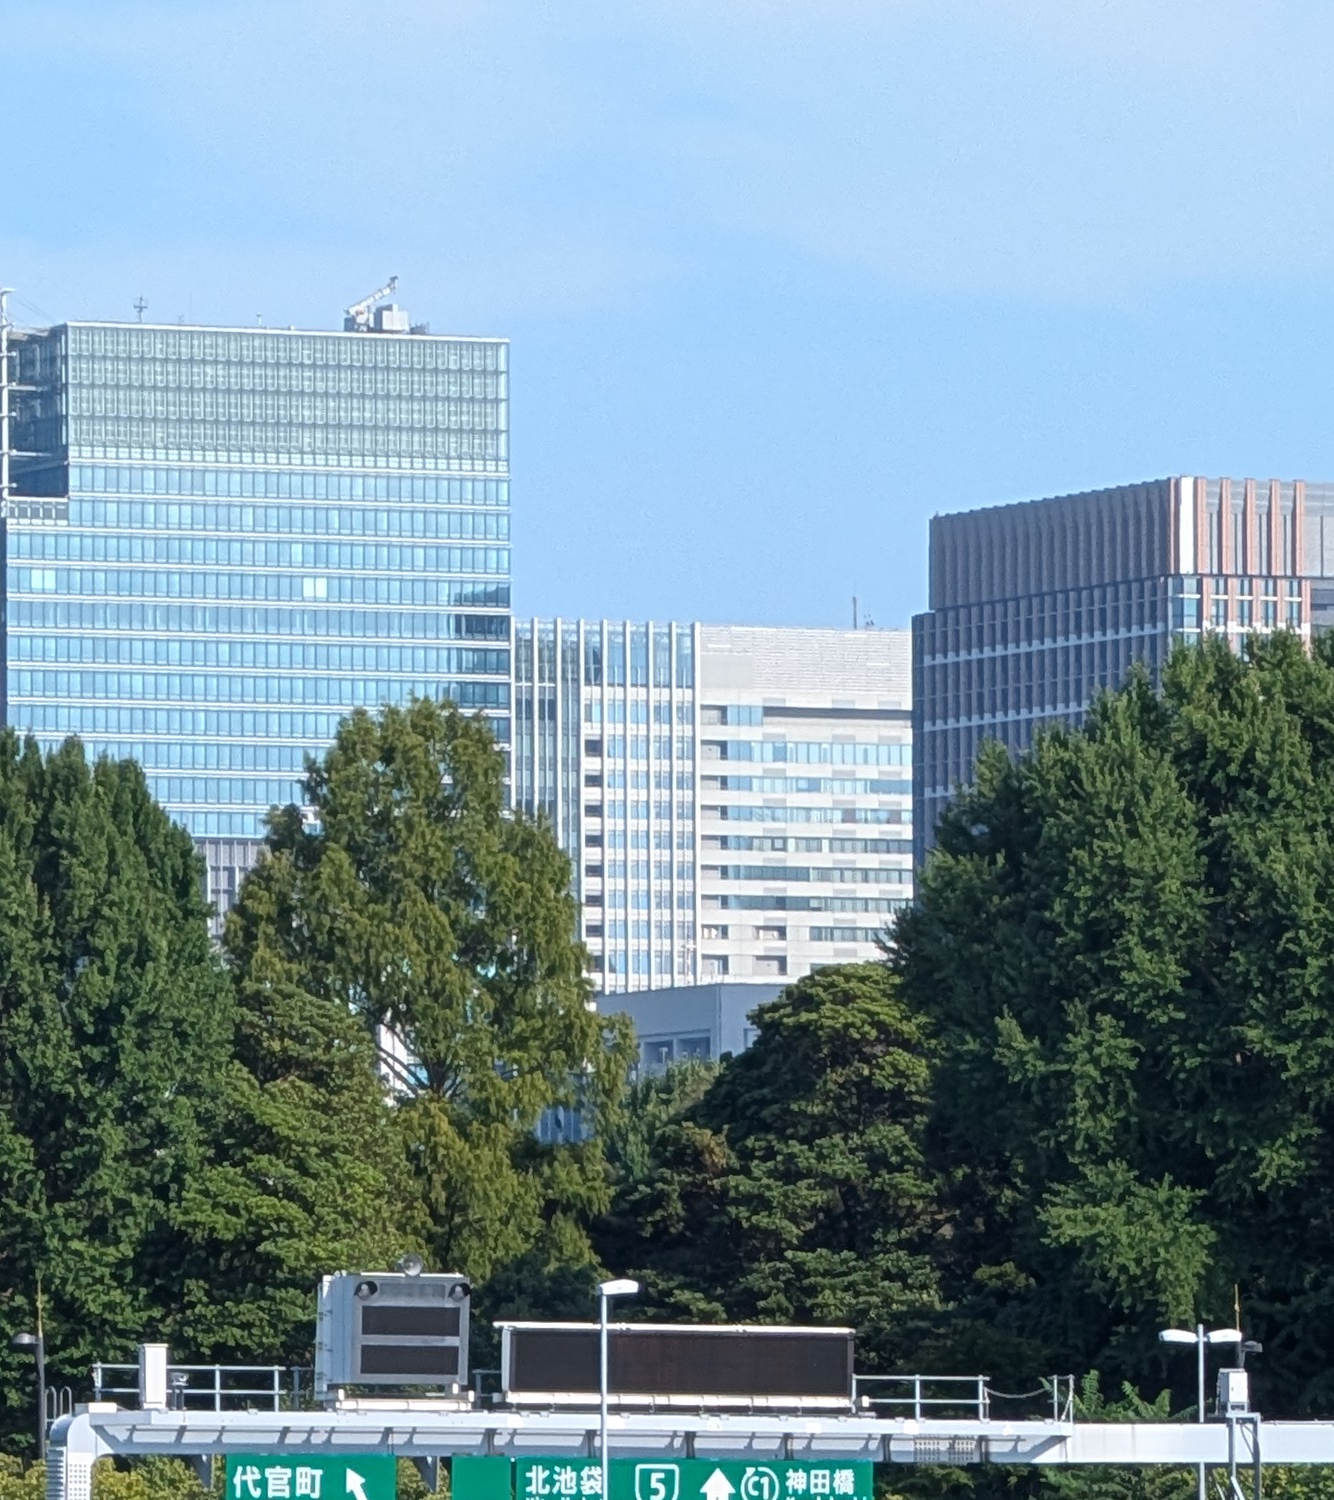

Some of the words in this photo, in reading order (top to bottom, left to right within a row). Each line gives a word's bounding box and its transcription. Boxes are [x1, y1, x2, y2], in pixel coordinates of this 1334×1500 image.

[233, 1465, 323, 1498] 代官町
[525, 1465, 602, 1495] 北池袋
[747, 1476, 769, 1500] C1
[785, 1468, 855, 1494] 神田橋
